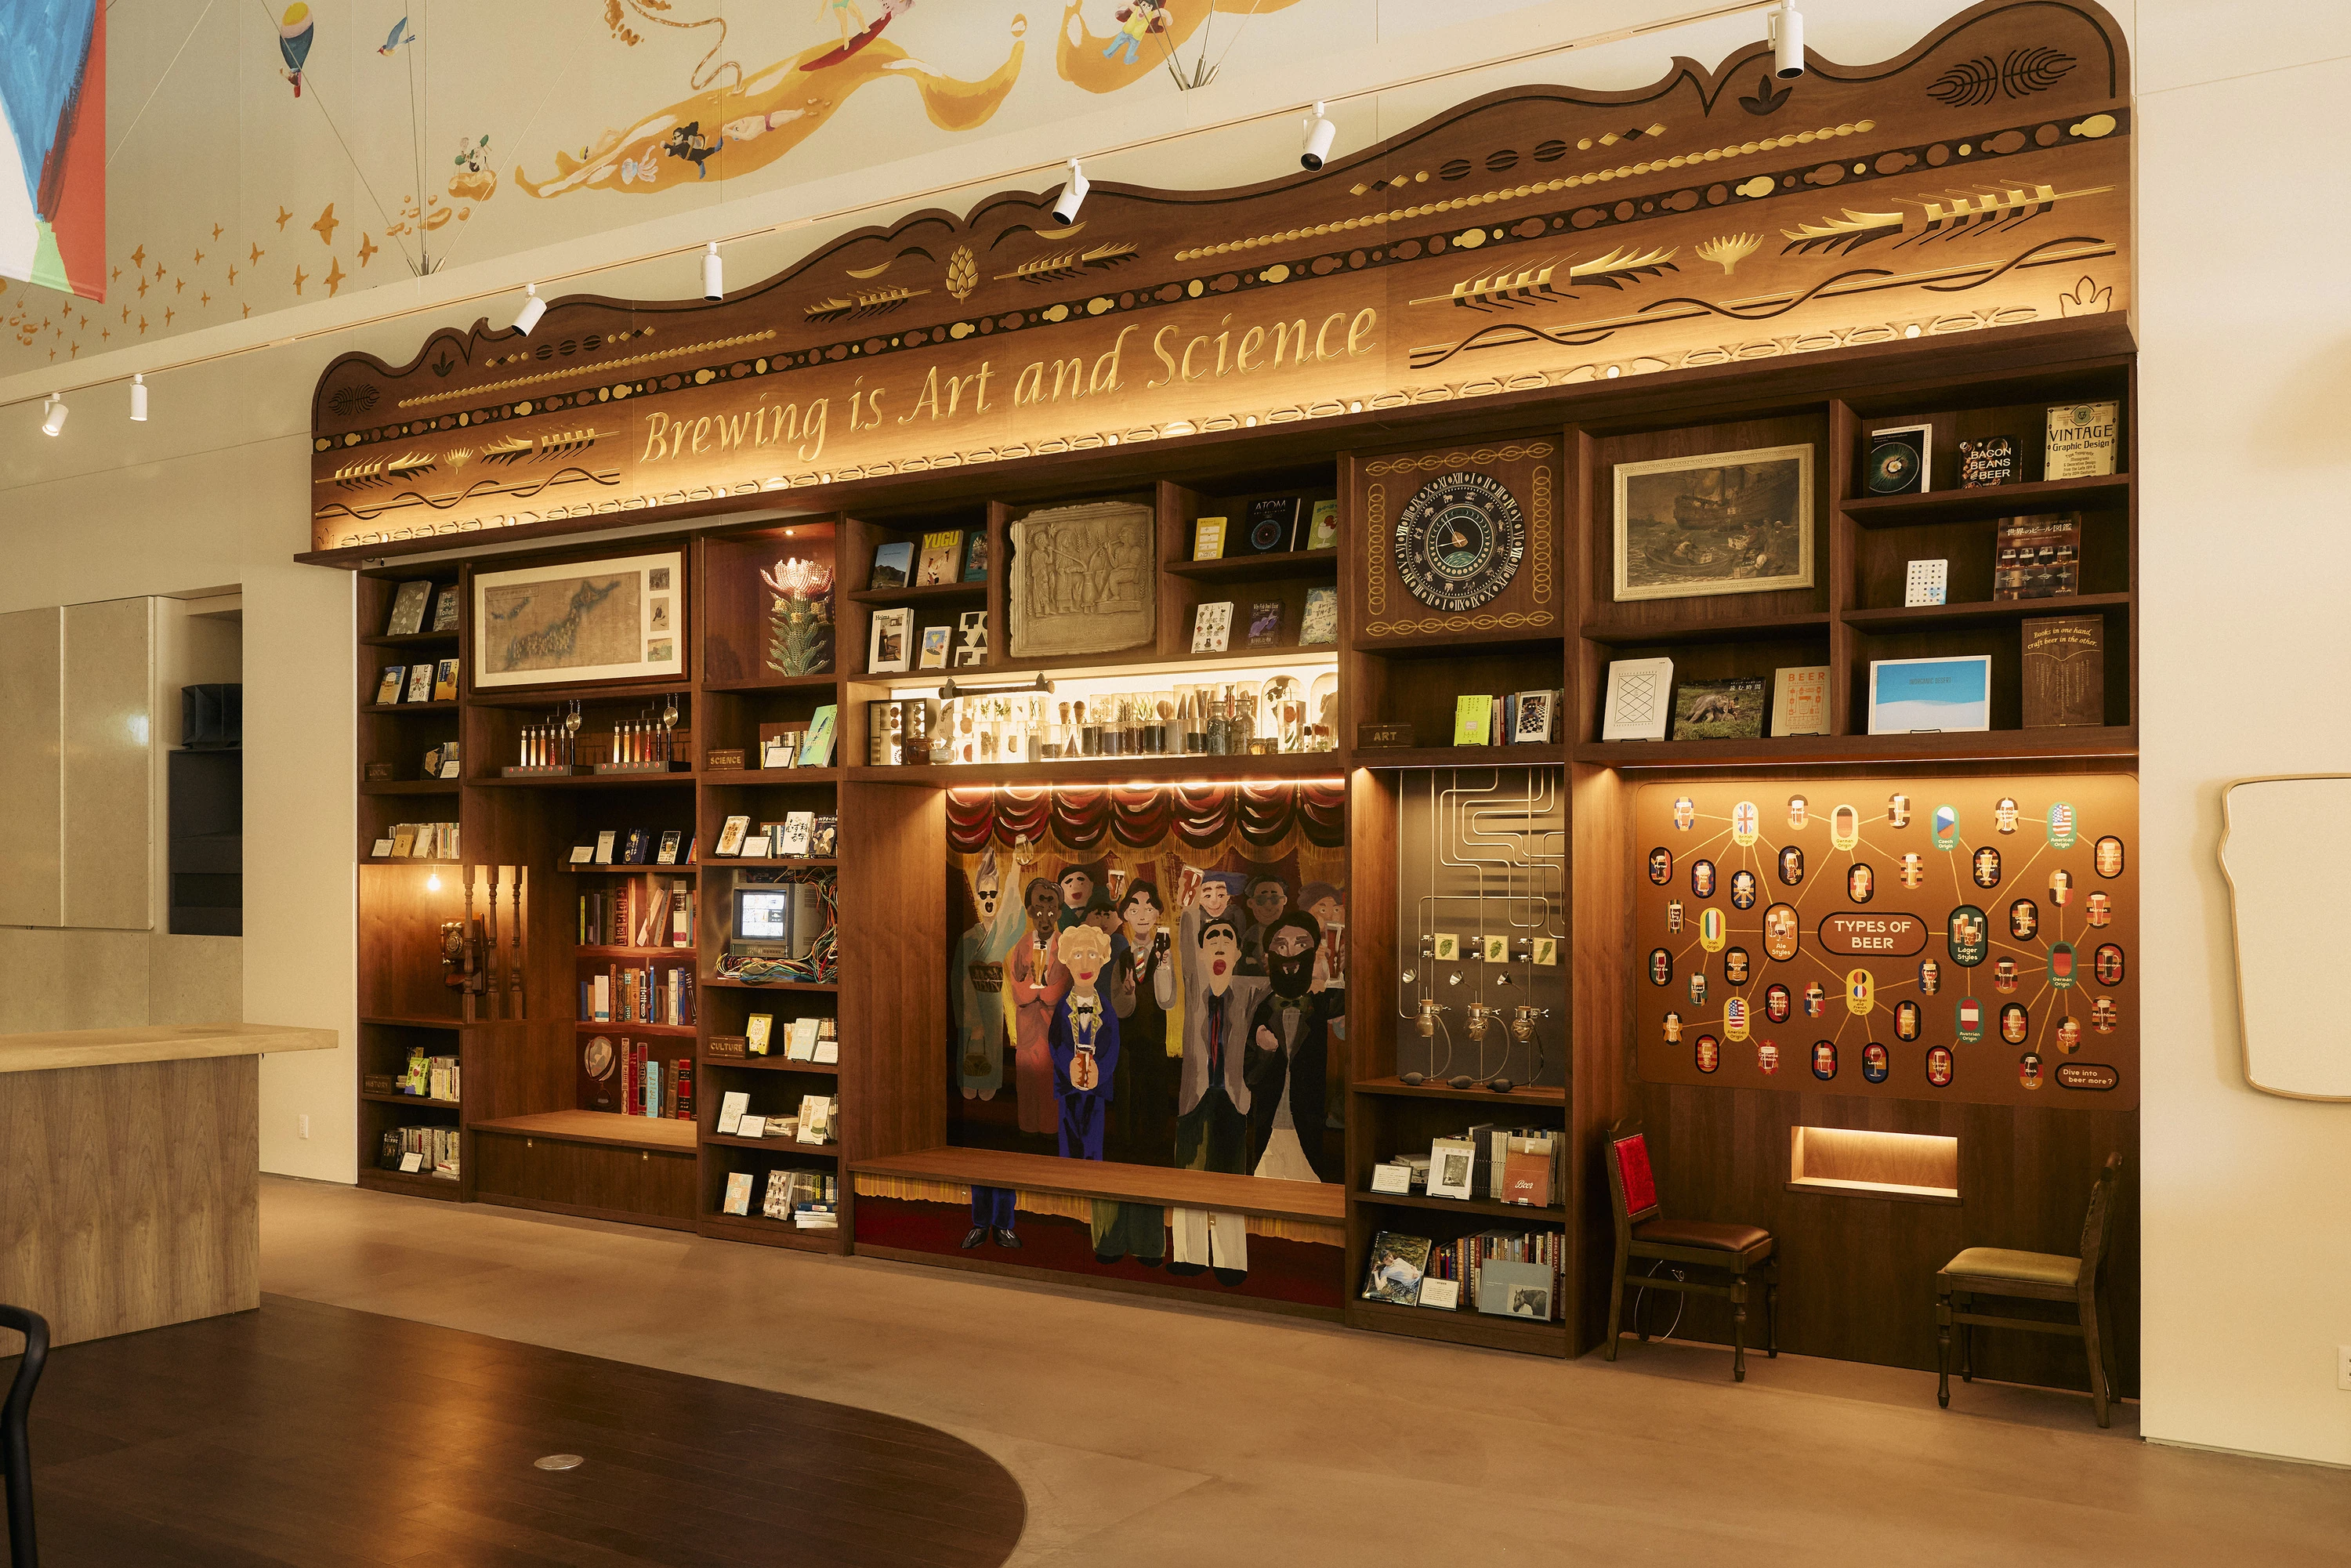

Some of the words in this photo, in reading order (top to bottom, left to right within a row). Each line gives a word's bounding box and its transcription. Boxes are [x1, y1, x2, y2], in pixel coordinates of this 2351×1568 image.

[639, 393, 829, 463] Brewing
[848, 375, 885, 433] is
[897, 361, 995, 425] Art
[1014, 324, 1139, 407] and
[1147, 308, 1377, 389] Science
[2049, 425, 2114, 442] VINTAGE
[2052, 443, 2082, 452] Graphic
[2085, 440, 2110, 449] Design
[1971, 448, 2012, 460] BACON
[1970, 459, 2011, 470] BEANS
[1980, 469, 2010, 480] BEER
[1255, 499, 1286, 511] ATOM
[2006, 523, 2073, 537] 世界のビール図鑑
[923, 531, 959, 549] YUGU
[2034, 628, 2052, 639] Books
[2074, 627, 2092, 637] hand,
[2027, 639, 2043, 650] craft
[2079, 639, 2098, 647] other.
[1788, 672, 1825, 682] BEER
[1374, 731, 1397, 741] ART
[710, 755, 741, 765] SCIENCE
[1834, 921, 1886, 932] TYPES
[1889, 921, 1911, 933] OF
[1851, 936, 1894, 949] BEER
[1957, 954, 1978, 962] Styles
[710, 1042, 743, 1052] CULTURE
[365, 1081, 389, 1089] HISTORY
[1524, 1140, 1536, 1153] F
[1515, 1179, 1534, 1190] Beer
